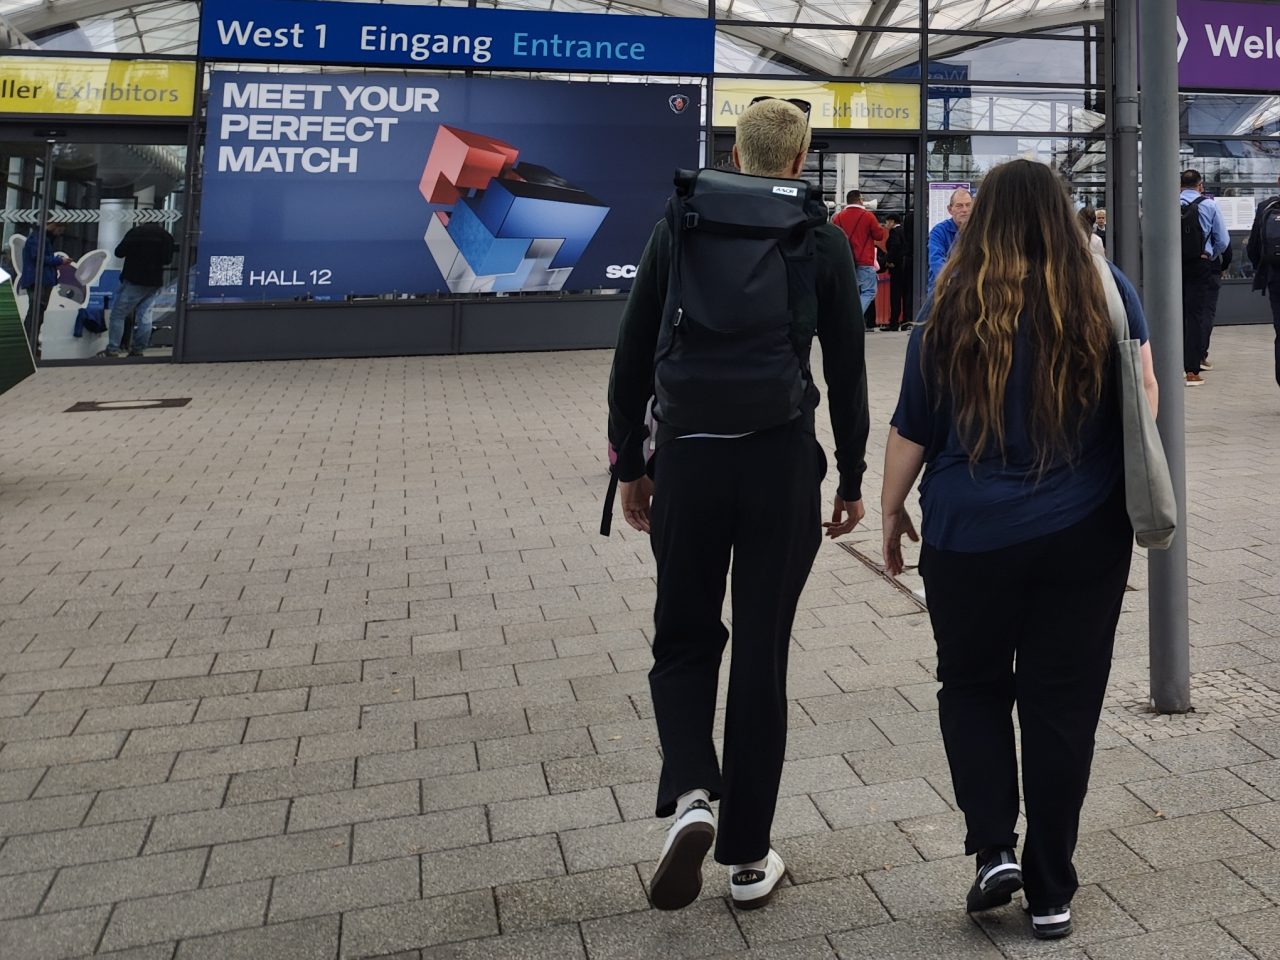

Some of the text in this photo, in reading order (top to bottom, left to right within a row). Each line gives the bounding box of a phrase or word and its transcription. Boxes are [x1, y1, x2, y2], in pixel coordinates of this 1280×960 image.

[216, 19, 646, 63] West 1 Eingang Entrance
[1, 79, 178, 102] ller Exhibitors
[222, 82, 440, 113] MEET YOUR
[720, 99, 910, 120] Au Exhibitors
[220, 113, 399, 143] PERFECT
[217, 145, 359, 174] MATCH
[249, 269, 332, 286] HALL 12
[605, 264, 640, 279] SC
[736, 873, 758, 882] VEJA
